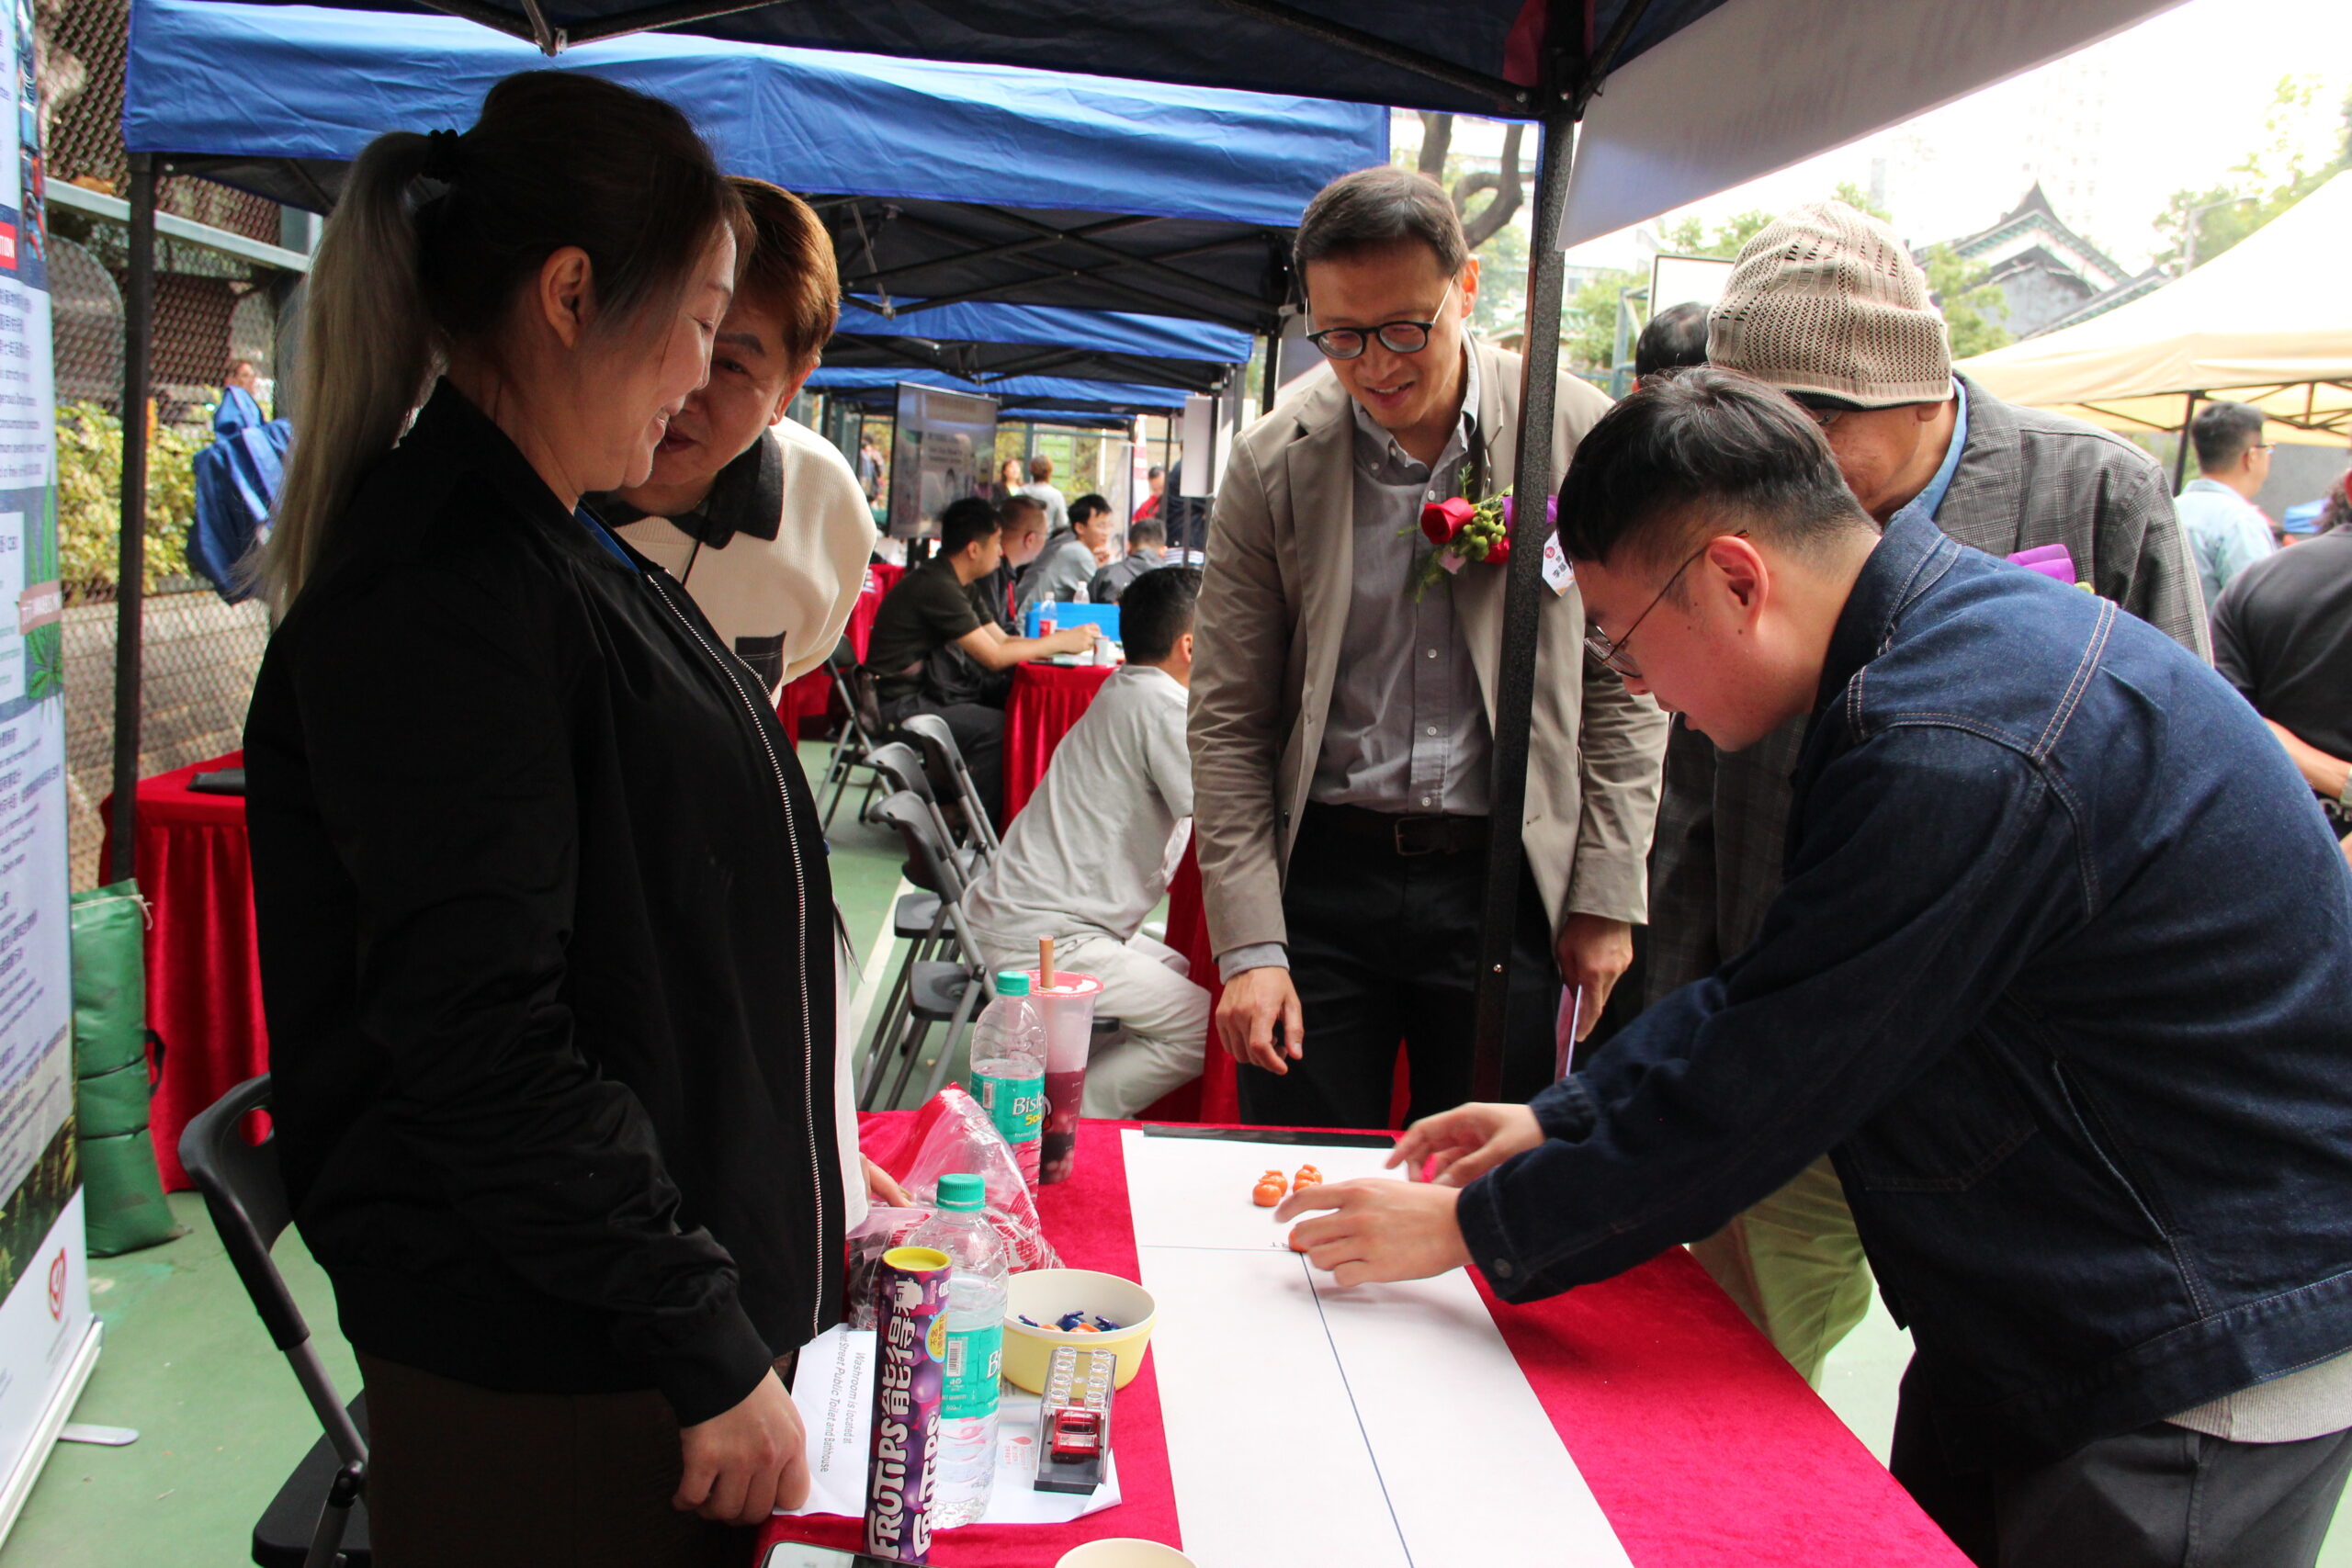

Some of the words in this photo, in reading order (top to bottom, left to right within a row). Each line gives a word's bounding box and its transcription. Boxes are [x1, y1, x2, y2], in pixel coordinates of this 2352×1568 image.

[836, 1340, 851, 1366] Street
[831, 1366, 845, 1396] Public
[847, 1352, 865, 1400] Washroom
[827, 1396, 841, 1421] Toilet
[846, 1400, 855, 1410] is
[825, 1421, 835, 1436] and
[843, 1410, 855, 1436] located
[820, 1437, 835, 1472] Bathhouse
[868, 1417, 908, 1560] FRUTIPS
